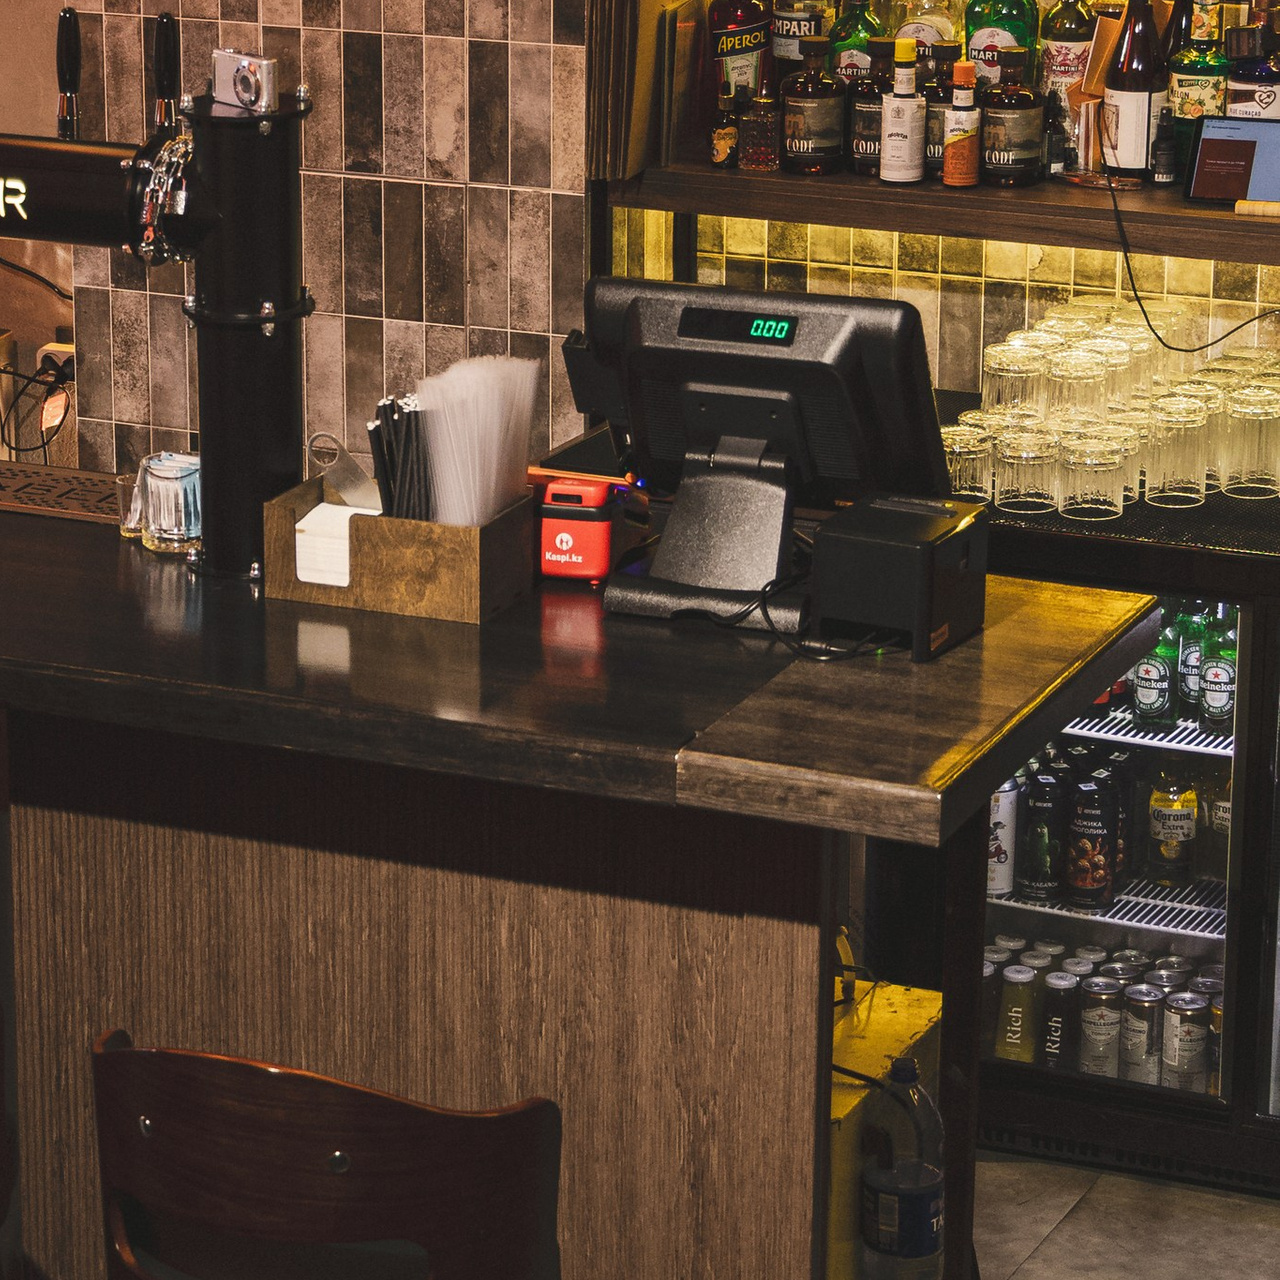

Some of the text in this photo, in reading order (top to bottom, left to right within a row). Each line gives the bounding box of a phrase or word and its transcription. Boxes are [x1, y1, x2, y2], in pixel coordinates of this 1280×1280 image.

[718, 31, 766, 54] APEROL
[971, 51, 997, 61] MART
[1170, 86, 1190, 99] MELON
[1239, 109, 1261, 117] CURAÇAO
[545, 551, 583, 564] Kaspi.kz
[1151, 697, 1163, 709] LAGER
[1221, 699, 1234, 712] LAGER
[1152, 808, 1193, 822] Corona
[1071, 824, 1108, 835] НОГОЛИКА
[1161, 822, 1185, 831] Extra
[1006, 1006, 1022, 1044] Rich
[1045, 1017, 1062, 1053] Rich
